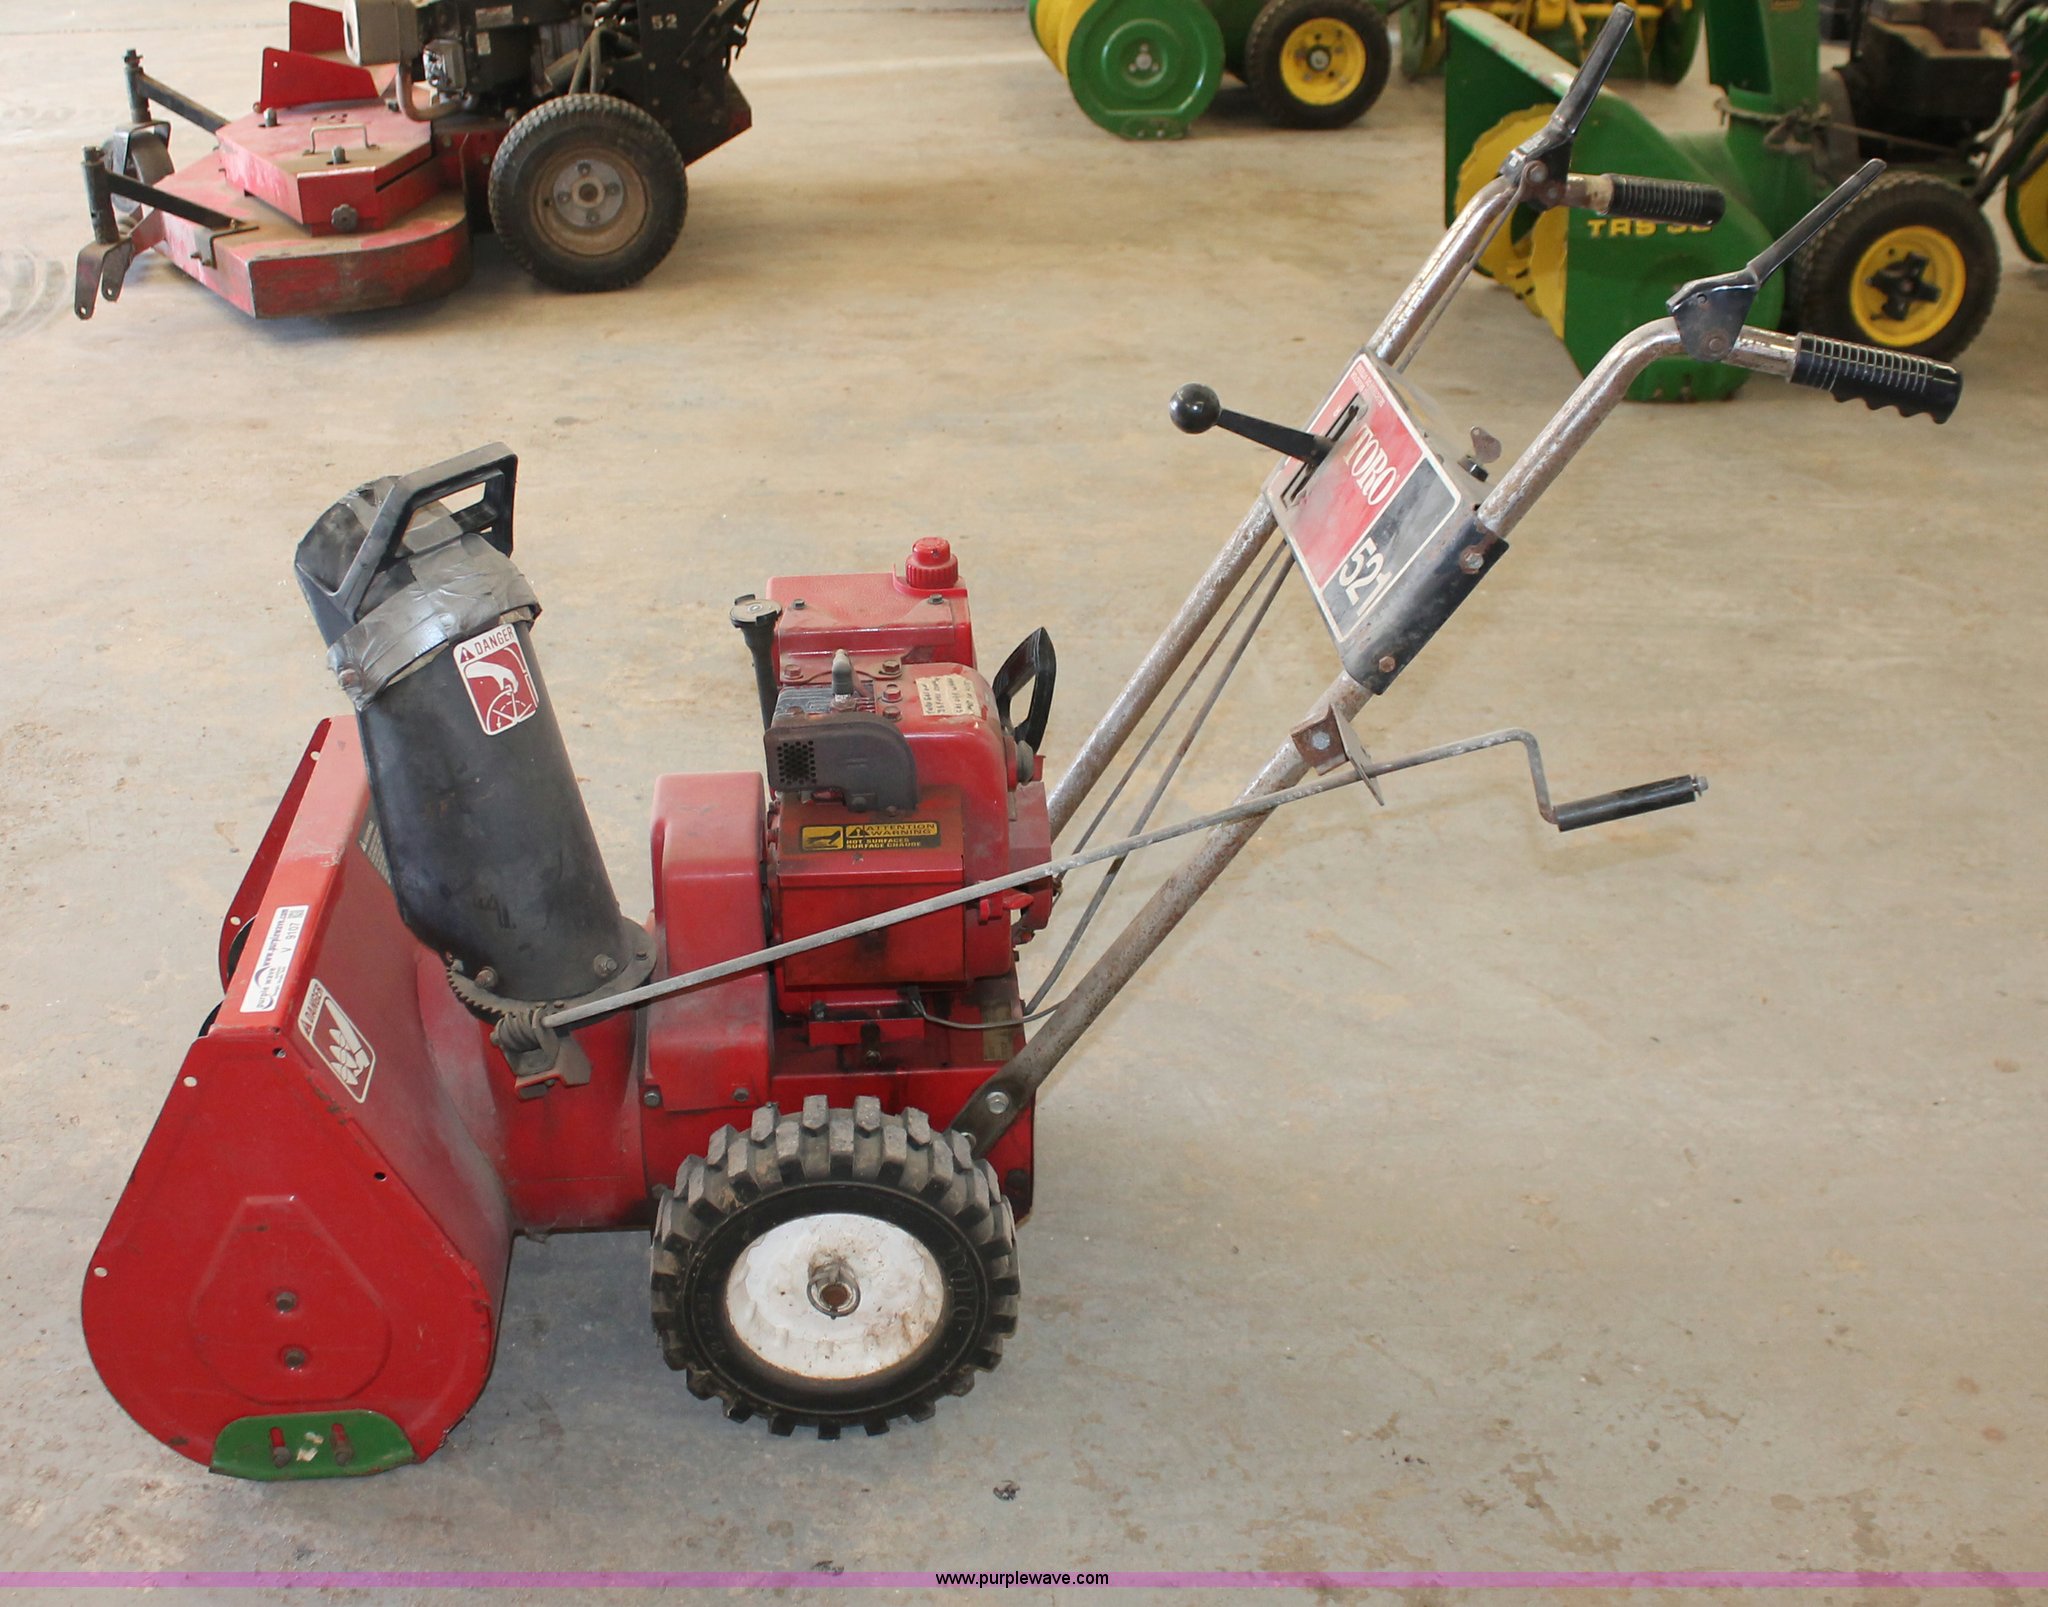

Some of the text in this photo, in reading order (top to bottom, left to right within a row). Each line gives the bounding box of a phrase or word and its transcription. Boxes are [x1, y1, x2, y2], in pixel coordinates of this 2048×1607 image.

[651, 14, 678, 29] 52
[1342, 423, 1398, 506] TORO
[1339, 537, 1392, 617] 521
[474, 626, 515, 655] DANGER
[866, 823, 935, 832] ATTENTION
[870, 829, 932, 837] WARNING
[263, 908, 289, 967] www.purplewave.com
[304, 983, 325, 1023] DANGER
